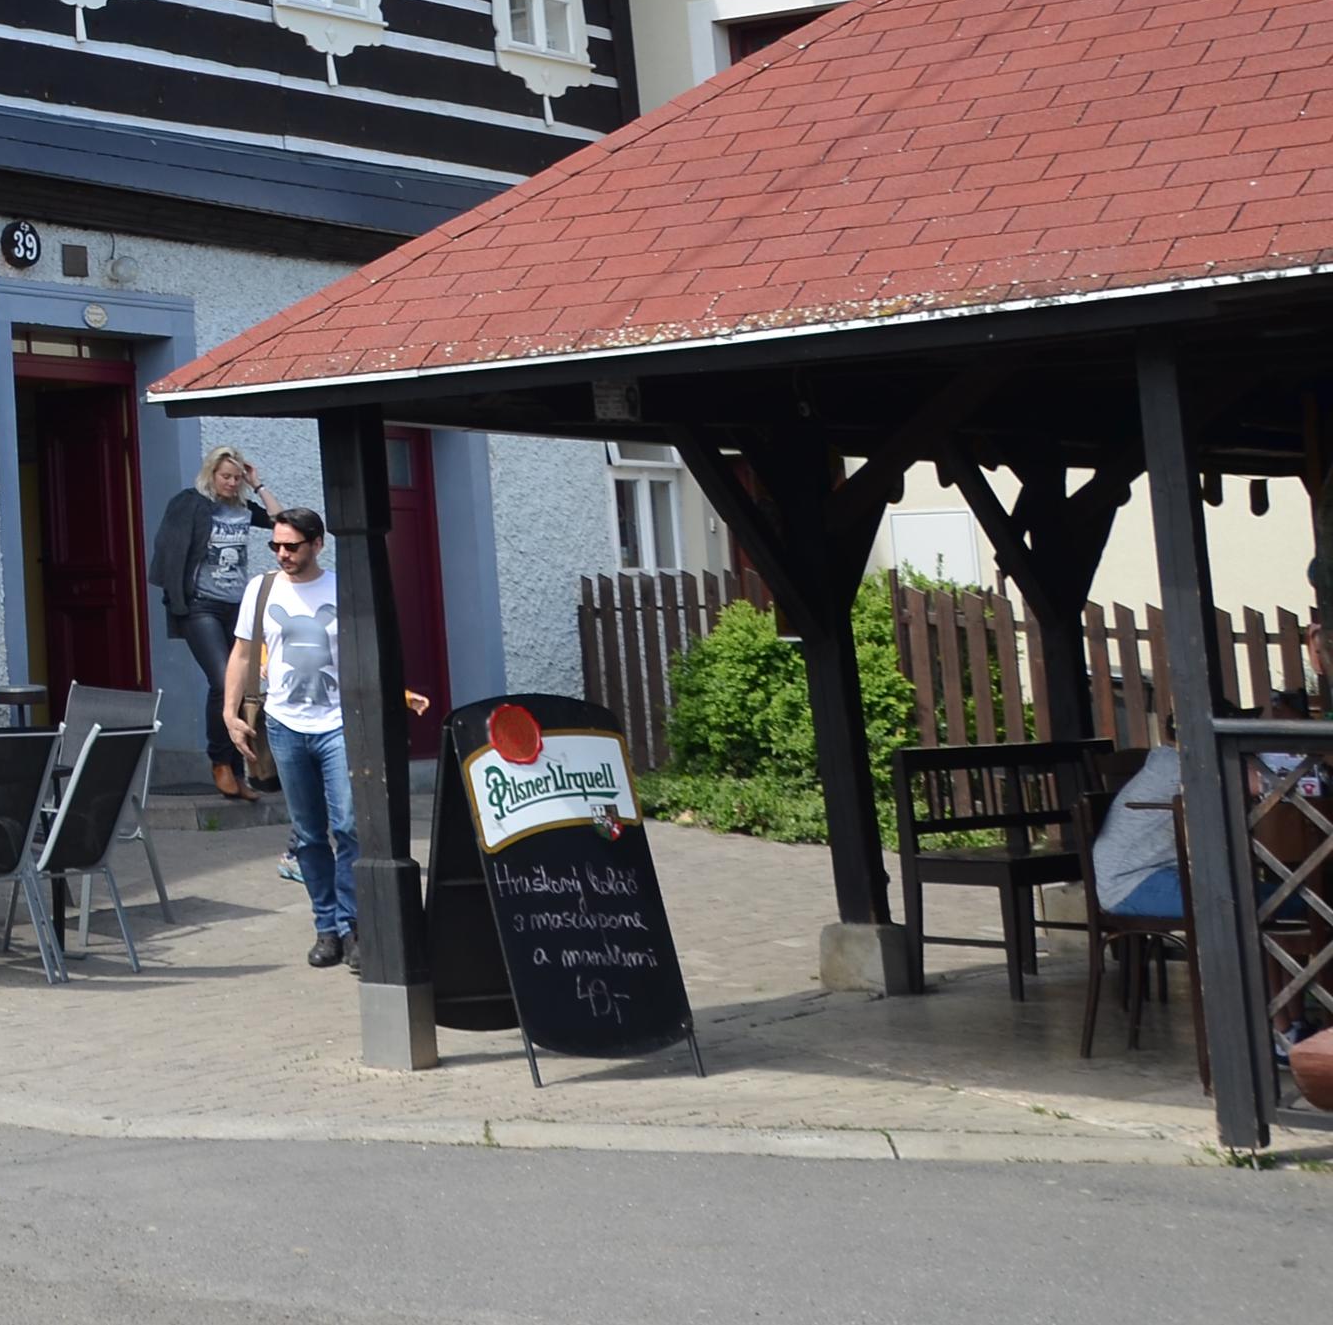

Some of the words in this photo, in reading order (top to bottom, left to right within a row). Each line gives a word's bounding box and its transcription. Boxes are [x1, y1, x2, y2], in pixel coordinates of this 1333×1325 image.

[13, 230, 37, 260] 39
[485, 765, 551, 820] Pilsner
[546, 762, 616, 801] Urquell
[493, 861, 586, 911] Hruškový
[585, 862, 639, 896] koláč
[530, 912, 648, 941] mascarpone
[533, 948, 551, 965] a
